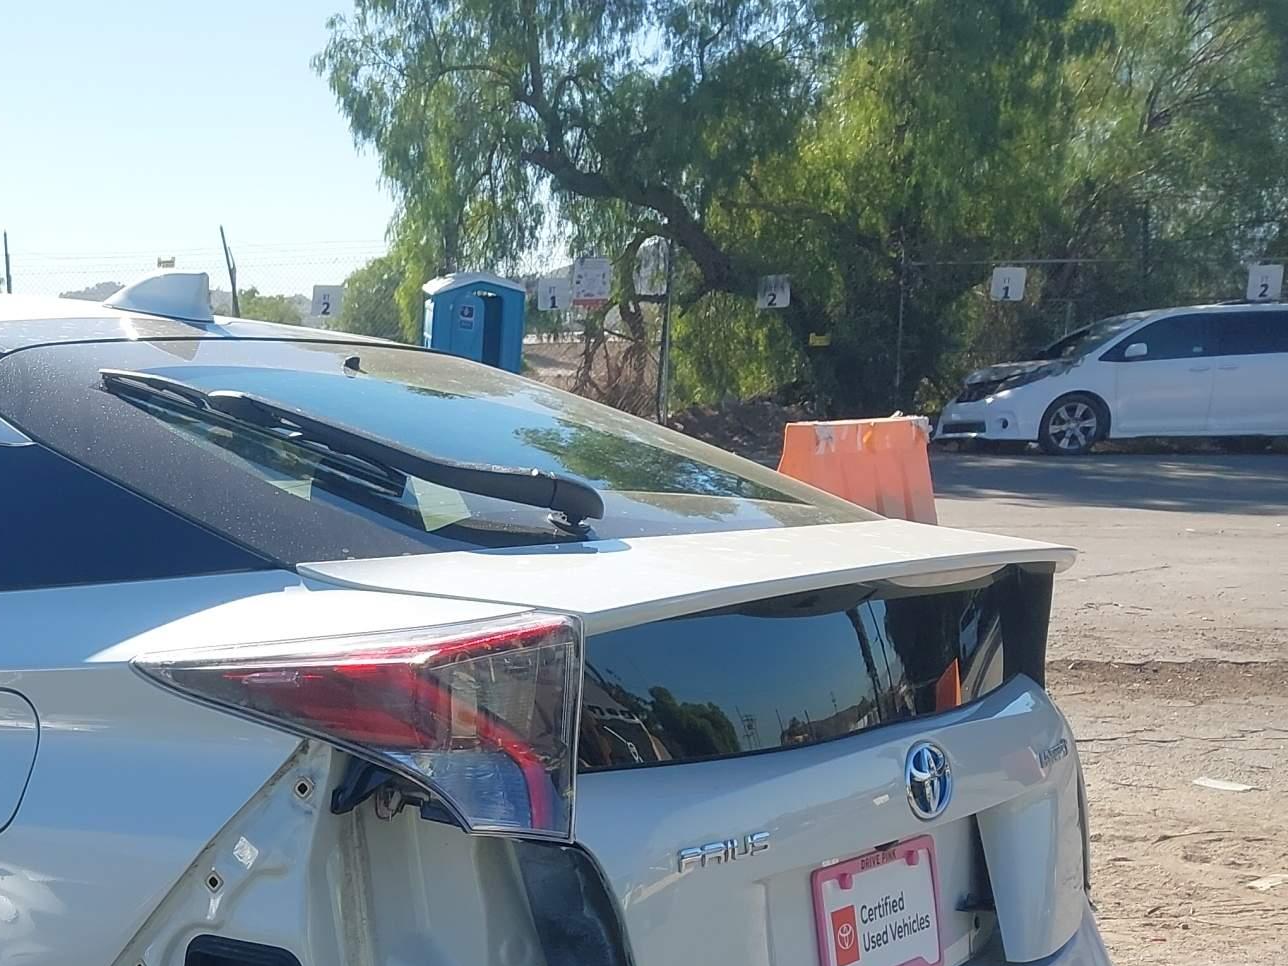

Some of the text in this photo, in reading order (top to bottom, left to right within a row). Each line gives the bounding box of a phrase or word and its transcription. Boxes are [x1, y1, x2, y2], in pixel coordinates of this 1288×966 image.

[1259, 284, 1269, 297] 2
[550, 296, 558, 308] 1
[767, 293, 776, 306] 2
[321, 302, 330, 315] 2
[678, 832, 771, 873] PRIUS
[860, 854, 881, 870] DRIVE
[860, 891, 905, 925] Certified
[862, 913, 931, 952] Used Vehicles
